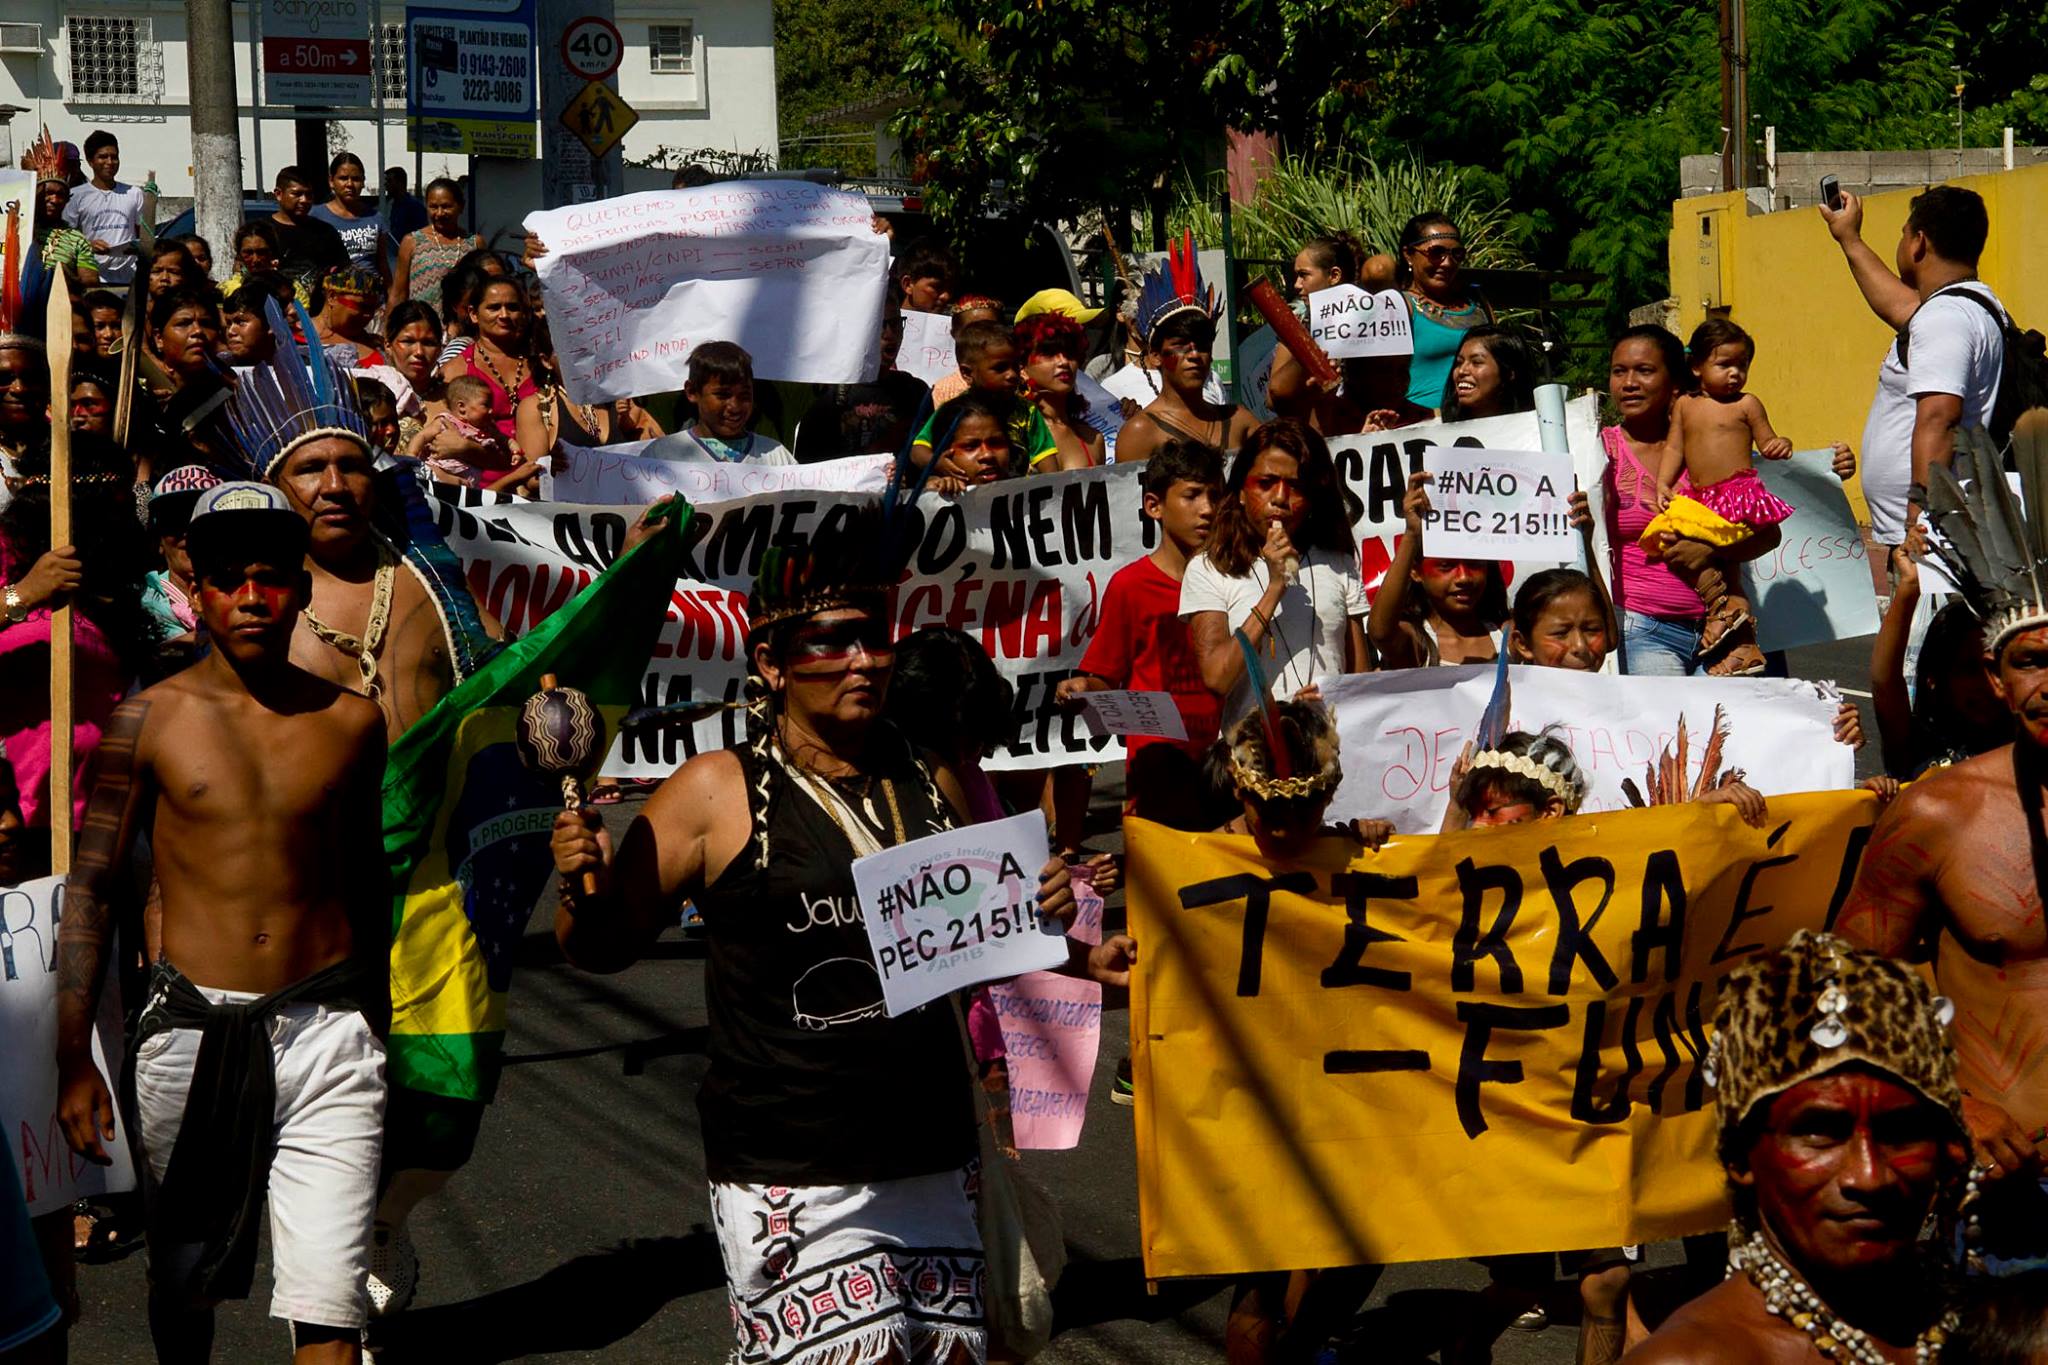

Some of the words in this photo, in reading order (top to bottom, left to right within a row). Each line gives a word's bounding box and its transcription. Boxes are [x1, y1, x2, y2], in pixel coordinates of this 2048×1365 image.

[491, 32, 501, 46] DE
[502, 32, 527, 48] VENDAS
[570, 32, 613, 57] 40
[280, 51, 290, 67] a
[295, 44, 336, 68] 50m
[460, 53, 468, 75] 9
[470, 54, 526, 78] 9143-2608
[580, 61, 607, 69] km/h
[463, 79, 522, 103] 3223-9086
[1319, 294, 1375, 320] #NÃO
[1384, 295, 1397, 311] A
[1312, 323, 1351, 340] PEC
[1358, 320, 1408, 339] 215!!!
[1438, 466, 1518, 497] #NÃO
[1535, 475, 1557, 498] A
[990, 480, 1112, 570] NEM
[1425, 509, 1482, 534] PEC
[1492, 512, 1568, 537] 215!!!
[876, 861, 971, 923] #NÃO
[997, 851, 1026, 885] A
[1177, 845, 1688, 999] TERRA
[1710, 820, 1800, 966] É
[879, 928, 938, 981] PEC
